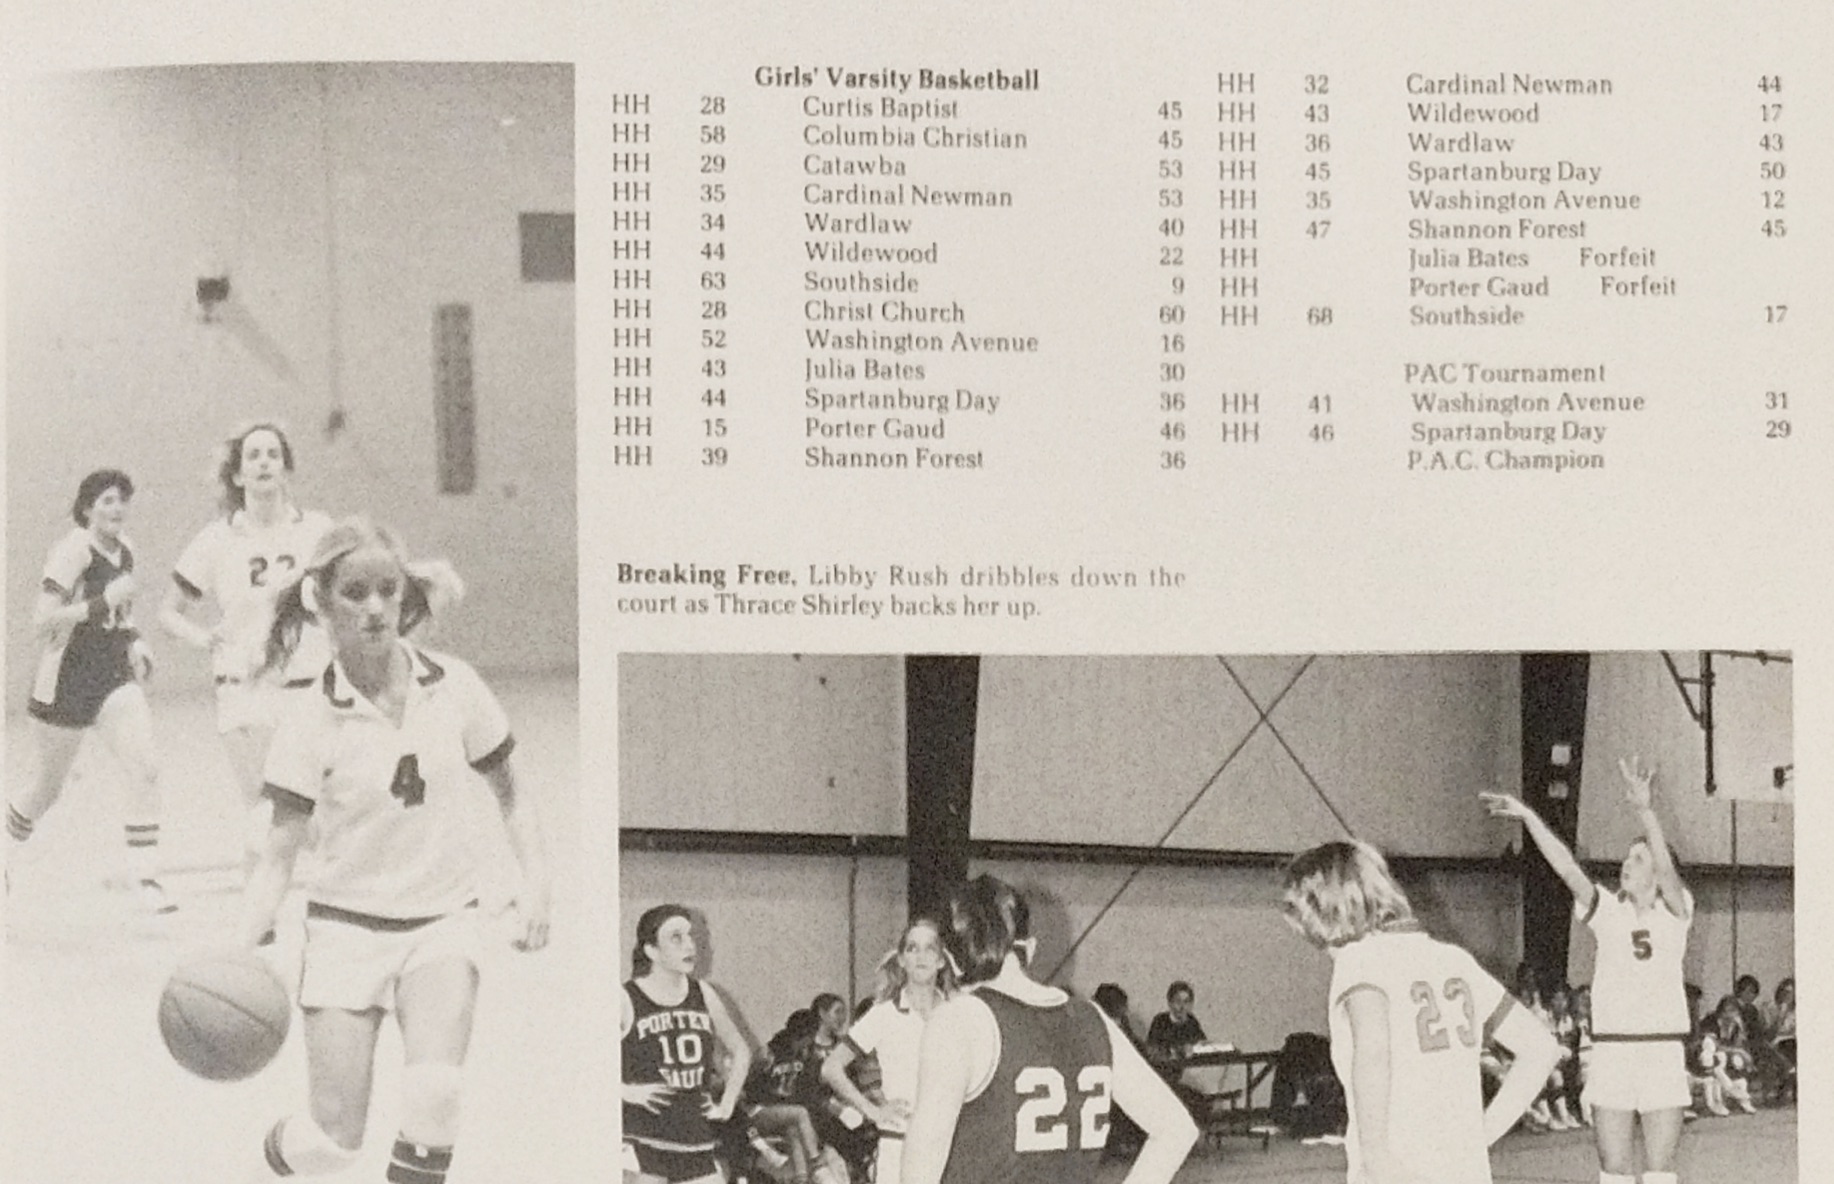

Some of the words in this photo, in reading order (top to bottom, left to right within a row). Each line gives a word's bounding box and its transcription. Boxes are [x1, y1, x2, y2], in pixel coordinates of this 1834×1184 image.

[754, 65, 819, 88] Girls'
[826, 66, 912, 95] Varsity
[918, 67, 1039, 91] Basketball
[1303, 73, 1330, 96] 32
[1405, 71, 1506, 96] Cardinal
[1512, 72, 1613, 96] Newman
[1757, 74, 1782, 94] 44
[699, 95, 727, 116] 28
[802, 95, 874, 118] Curtis
[880, 95, 958, 123] Baptist
[1304, 103, 1330, 124] 43
[1406, 101, 1540, 124] Wildewood
[1760, 102, 1784, 123] 17
[699, 124, 727, 145] 58
[802, 123, 916, 148] Columbia
[922, 124, 1028, 149] Christian
[1304, 132, 1332, 153] 36
[1407, 130, 1516, 154] Wardlaw
[1758, 132, 1785, 152] 43
[699, 154, 727, 174] 29
[802, 153, 907, 177] Catawba
[1304, 160, 1332, 182] 45
[1407, 159, 1552, 186] Spartanburg
[1557, 160, 1602, 186] Day
[1760, 160, 1787, 181] 50
[699, 183, 727, 204] 35
[803, 182, 905, 206] Cardinal
[911, 183, 1013, 208] Newman
[1305, 189, 1332, 210] 35
[1408, 188, 1547, 215] Washington
[1553, 189, 1642, 210] Avenue
[1761, 189, 1786, 210] 12
[700, 212, 726, 232] 34
[803, 211, 913, 235] Wardlaw
[1305, 219, 1332, 240] 47
[1407, 217, 1512, 240] Shannon
[1518, 217, 1587, 240] Forest
[1760, 218, 1788, 239] 45
[700, 241, 726, 261] 44
[804, 239, 938, 264] Wildewood
[1408, 246, 1461, 273] Julia
[1467, 246, 1530, 269] Bates
[1579, 245, 1657, 268] Forfeit
[700, 270, 727, 291] 63
[803, 269, 920, 294] Southside
[1409, 276, 1482, 298] Porter
[1486, 274, 1550, 298] Gaud
[1600, 273, 1677, 297] Forfeit
[701, 300, 728, 320] 28
[803, 298, 873, 322] Christ
[880, 299, 965, 324] Church
[1306, 306, 1334, 326] 68
[1409, 303, 1526, 327] Southside
[701, 328, 728, 350] 52
[805, 327, 944, 355] Washington
[950, 330, 1039, 353] Avenue
[701, 358, 727, 378] 43
[804, 356, 857, 383] Julia
[863, 357, 926, 381] Bates
[1403, 362, 1458, 385] PAC
[1461, 362, 1606, 384] Tournament
[700, 388, 727, 408] 44
[804, 386, 950, 415] Spartanburg
[955, 388, 1001, 415] Day
[1308, 393, 1332, 415] 41
[1410, 391, 1550, 417] Washington
[1556, 391, 1646, 413] Avenue
[1764, 390, 1789, 411] 31
[805, 416, 877, 439] Porter
[882, 417, 946, 440] Gaud
[1308, 423, 1335, 443] 46
[1410, 419, 1557, 447] Spartanburg
[1561, 419, 1608, 445] Day
[1765, 419, 1793, 440] 29
[701, 446, 729, 467] 39
[804, 445, 909, 469] Shannon
[915, 446, 984, 470] Forest
[1484, 448, 1605, 474] Champion
[616, 562, 727, 591] Breaking
[808, 563, 877, 591] Libby
[889, 564, 949, 587] Rush
[960, 564, 1060, 587] dribbles
[1070, 564, 1137, 587] down
[1149, 565, 1186, 587] the
[616, 595, 677, 614] court
[684, 598, 710, 615] as
[713, 592, 797, 616] Thrace
[801, 592, 884, 620] Shirley
[890, 593, 957, 616] backs
[962, 593, 1001, 617] her
[1007, 600, 1041, 621] up.
[390, 753, 426, 808] 4
[1630, 928, 1653, 961] 5
[1409, 977, 1477, 1053] 23
[658, 1033, 702, 1064] 10
[1014, 1064, 1112, 1152] 22
